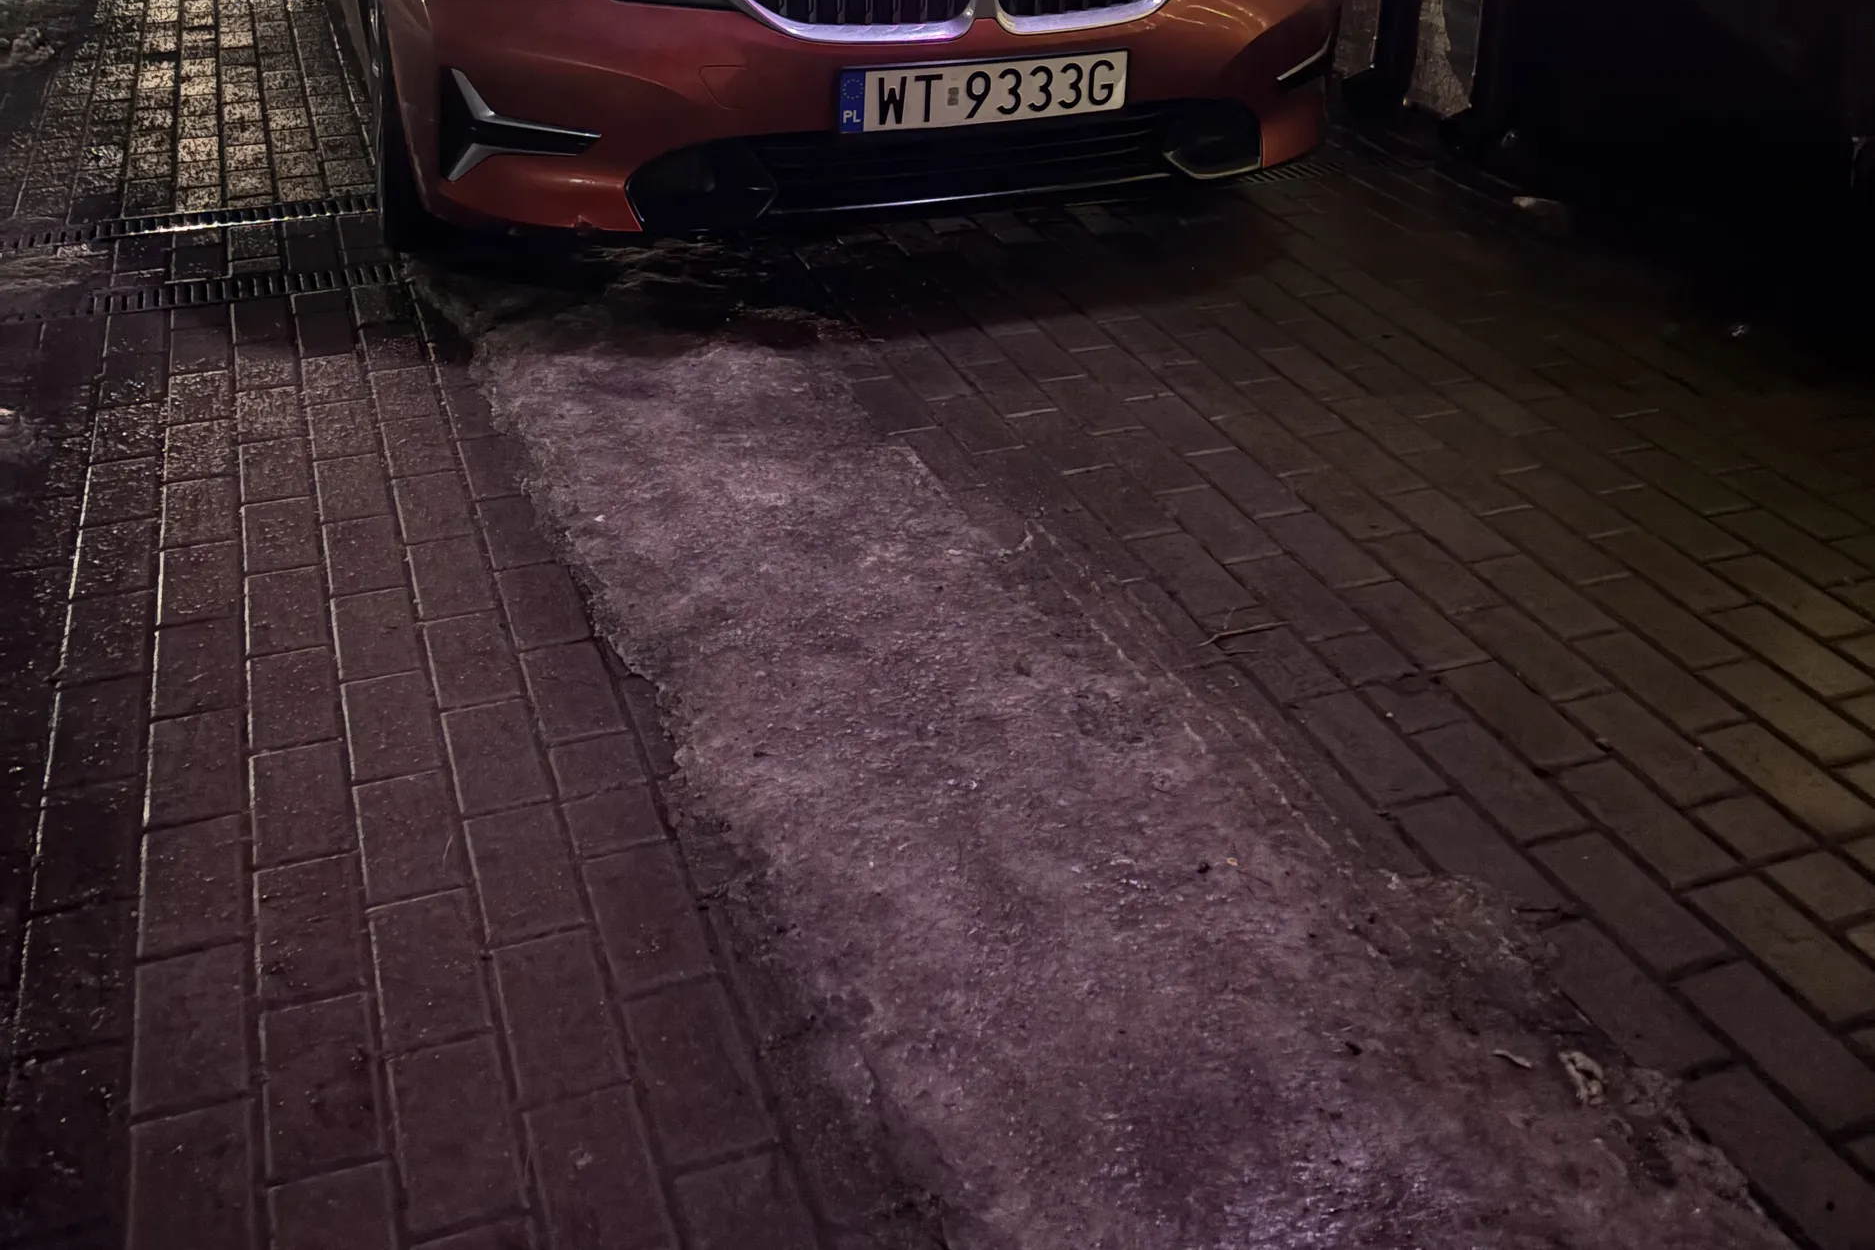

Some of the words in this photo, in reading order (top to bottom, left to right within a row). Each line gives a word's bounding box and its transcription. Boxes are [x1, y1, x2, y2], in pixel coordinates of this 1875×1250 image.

[877, 74, 943, 125] WT
[964, 59, 1115, 120] 9333G
[842, 110, 861, 124] PL
